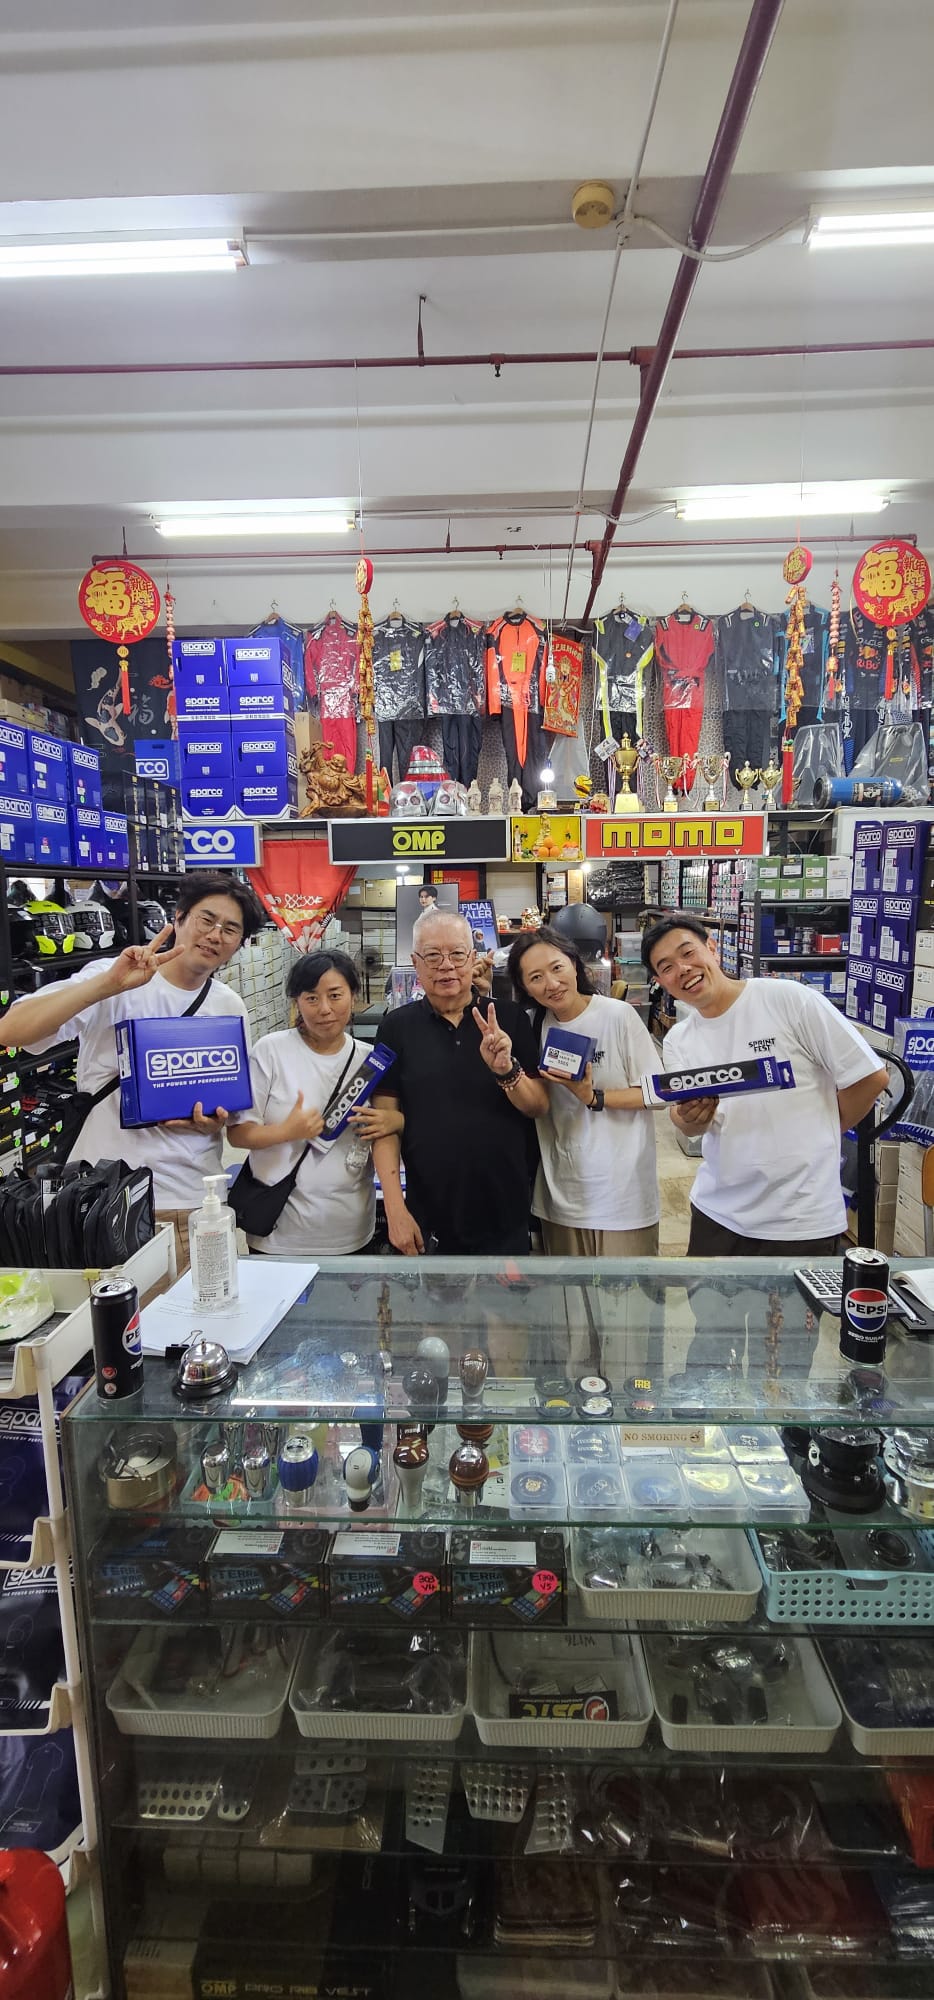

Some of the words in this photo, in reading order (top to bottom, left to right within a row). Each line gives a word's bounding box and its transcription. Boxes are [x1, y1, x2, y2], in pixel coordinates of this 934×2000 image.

[860, 551, 903, 598] 福
[86, 570, 131, 616] 福
[183, 643, 214, 652] sparco
[237, 649, 269, 658] sparco
[185, 697, 219, 706] sparco
[240, 696, 274, 705] sparco
[33, 738, 61, 756] sparco
[189, 744, 221, 752] sparco
[243, 743, 274, 751] sparco
[73, 750, 98, 767] sparco
[190, 789, 222, 797] sparco
[244, 787, 277, 796] sparco
[78, 809, 100, 823] sparco
[393, 831, 445, 850] OMP
[858, 832, 880, 843] sparco
[888, 829, 914, 841] sparco
[854, 900, 876, 909] sparco
[885, 900, 910, 910] sparco
[850, 962, 872, 974] sparco
[877, 971, 904, 985] sparco
[748, 1038, 775, 1047] SPRINT
[151, 1050, 236, 1076] sparco
[669, 1067, 742, 1090] sparco
[326, 1077, 365, 1128] sparco
[847, 1300, 887, 1314] PEPSI
[201, 1983, 237, 1994] OMP
[325, 1986, 371, 1996] VEST
